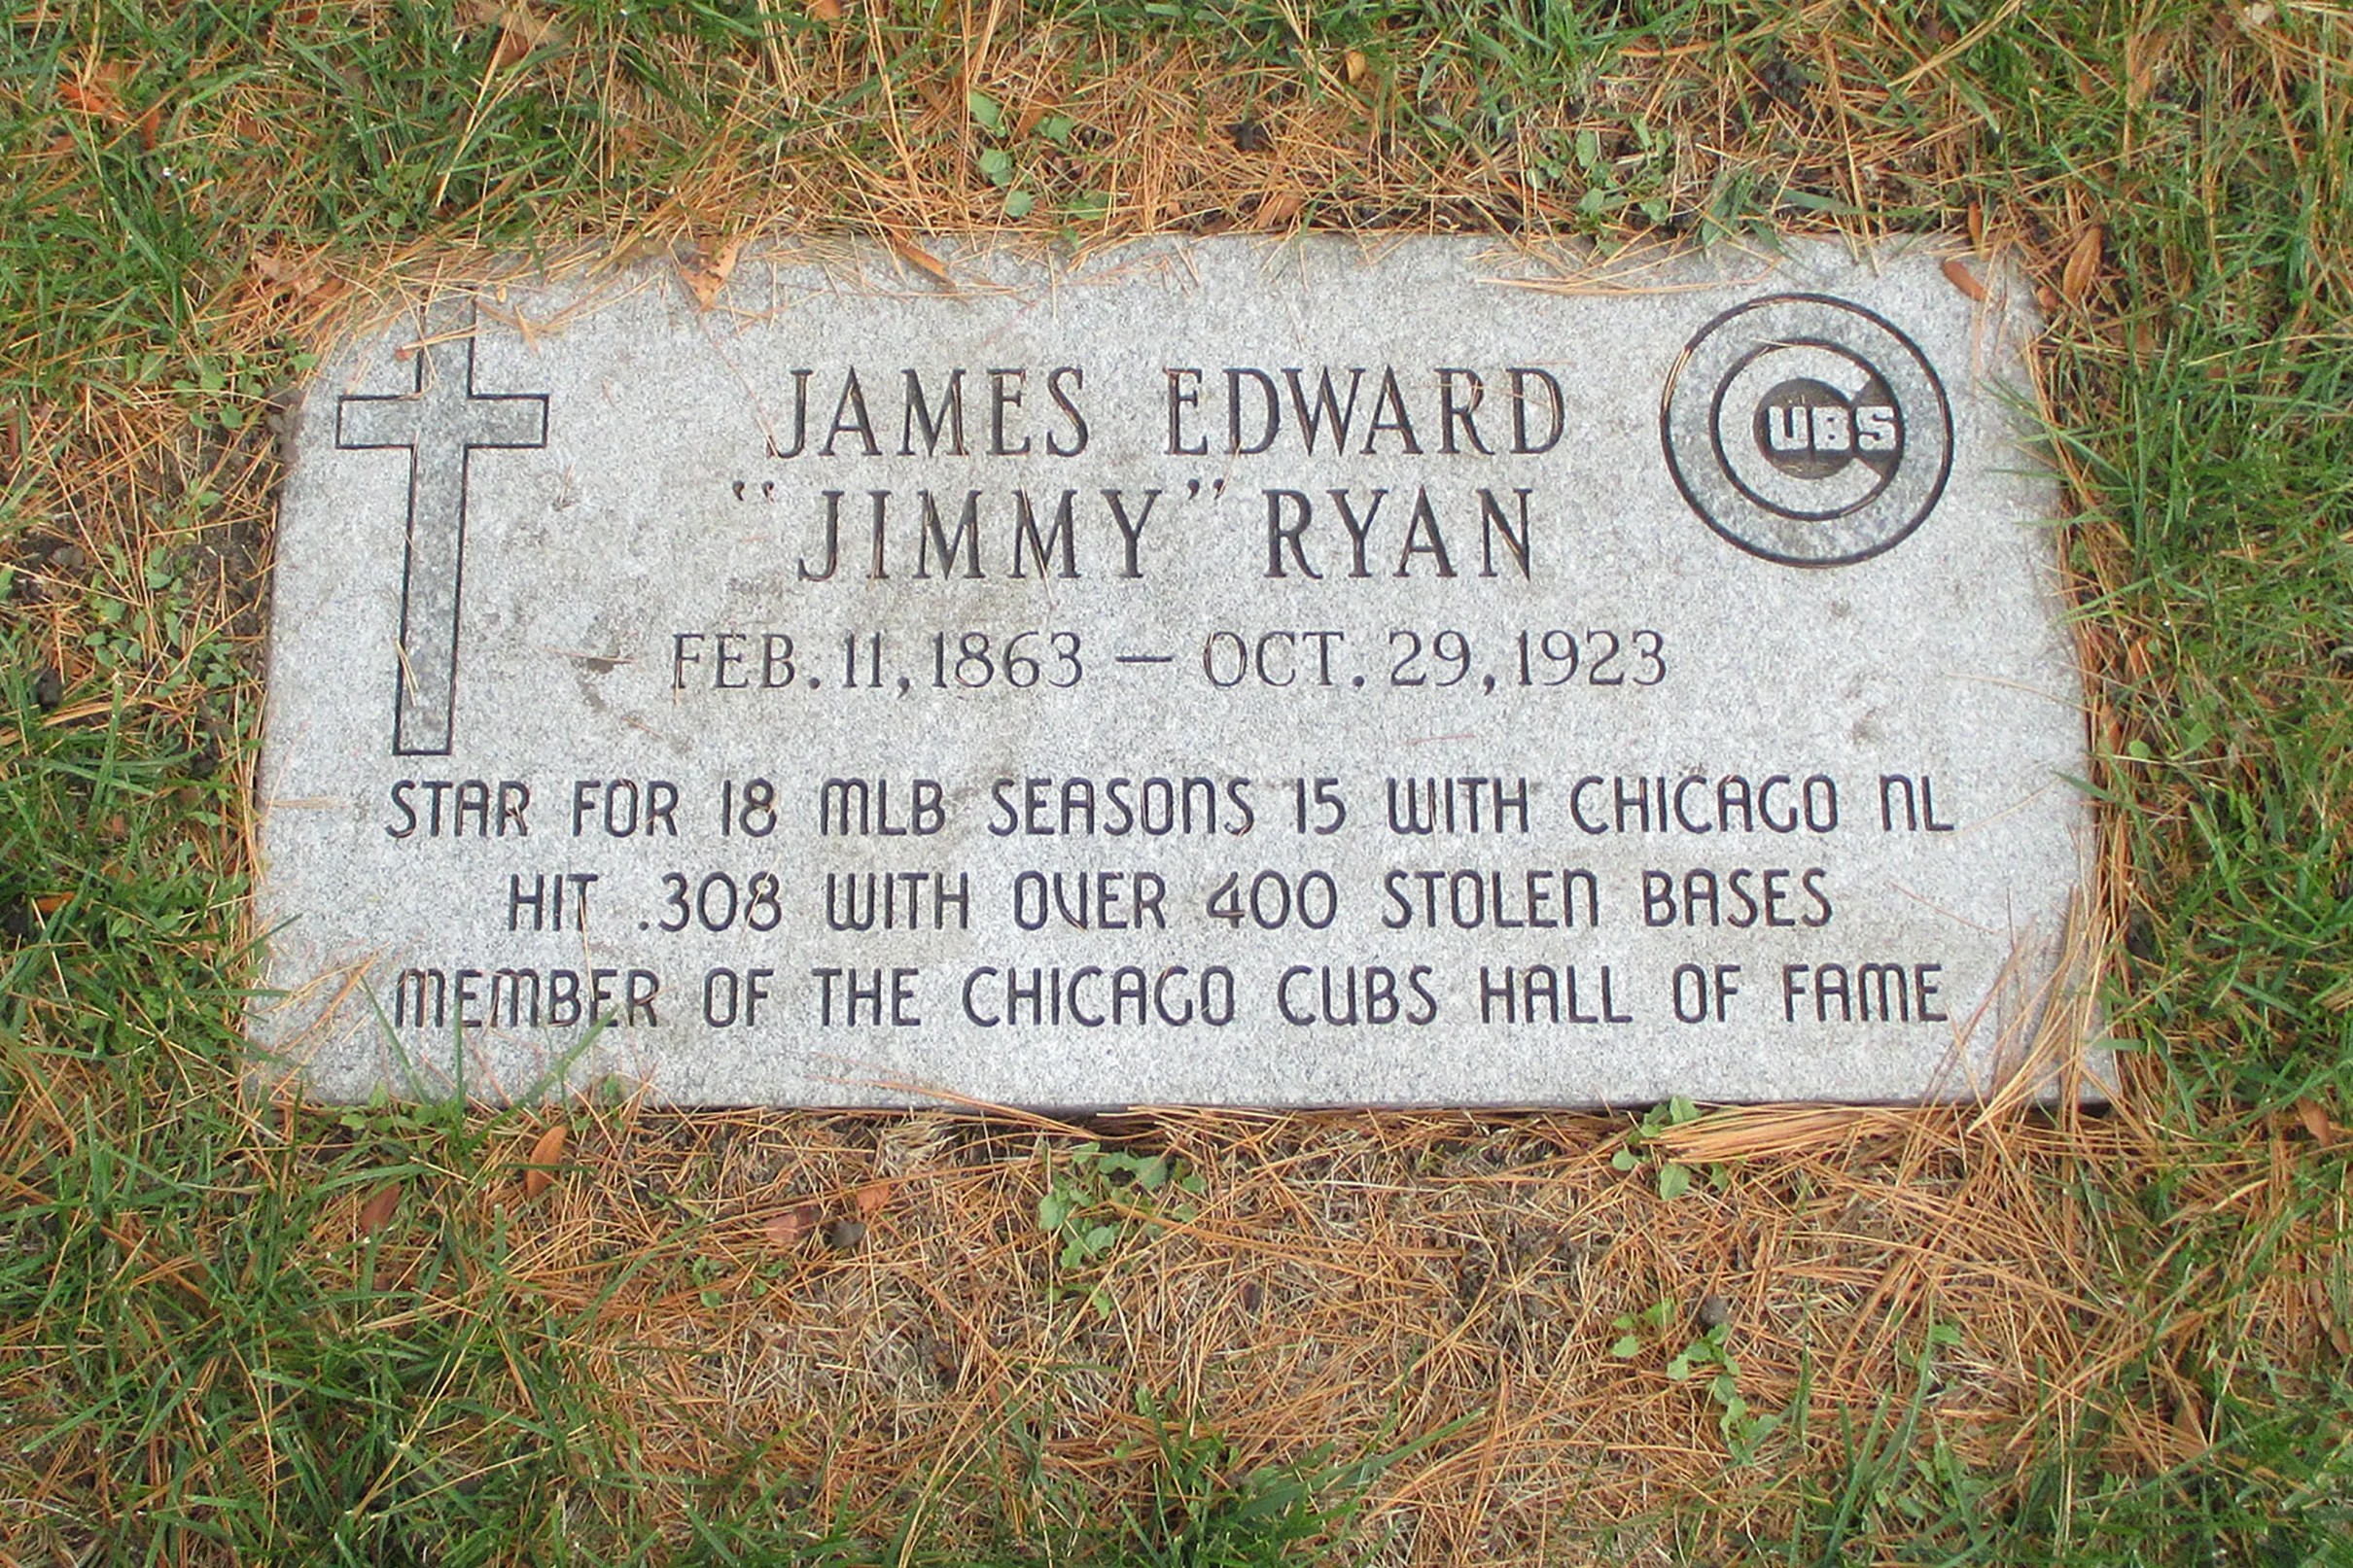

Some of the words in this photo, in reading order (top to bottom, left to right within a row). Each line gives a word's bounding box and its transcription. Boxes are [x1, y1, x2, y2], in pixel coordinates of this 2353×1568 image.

[766, 366, 1090, 458] JAMES
[1163, 366, 1567, 457] EDWARD
[1261, 487, 1534, 583] RYAN
[388, 779, 530, 837] STAR
[572, 779, 679, 837] FOR
[722, 779, 777, 837] 18
[821, 778, 945, 837] MLB
[987, 777, 1255, 836] SEASONS
[1294, 777, 1346, 835] 15
[1387, 776, 1528, 834] WITH
[1569, 775, 1838, 834] CHICAGO
[1880, 776, 1954, 833] NL
[508, 873, 600, 932] HIT
[638, 871, 781, 932] .308
[825, 872, 968, 932] WITH
[1013, 871, 1167, 930] OVER
[1206, 869, 1340, 930] 400
[1381, 869, 1599, 929] STOLEN
[1643, 867, 1834, 928] BASES
[394, 967, 659, 1029] MEMBER
[702, 967, 774, 1028] OF
[812, 967, 920, 1028] THE
[962, 965, 1236, 1028] CHICAGO
[1277, 964, 1439, 1027] CUBS
[1480, 965, 1634, 1024] HALL
[1671, 962, 1744, 1023] OF
[1781, 963, 1947, 1023] FAME
